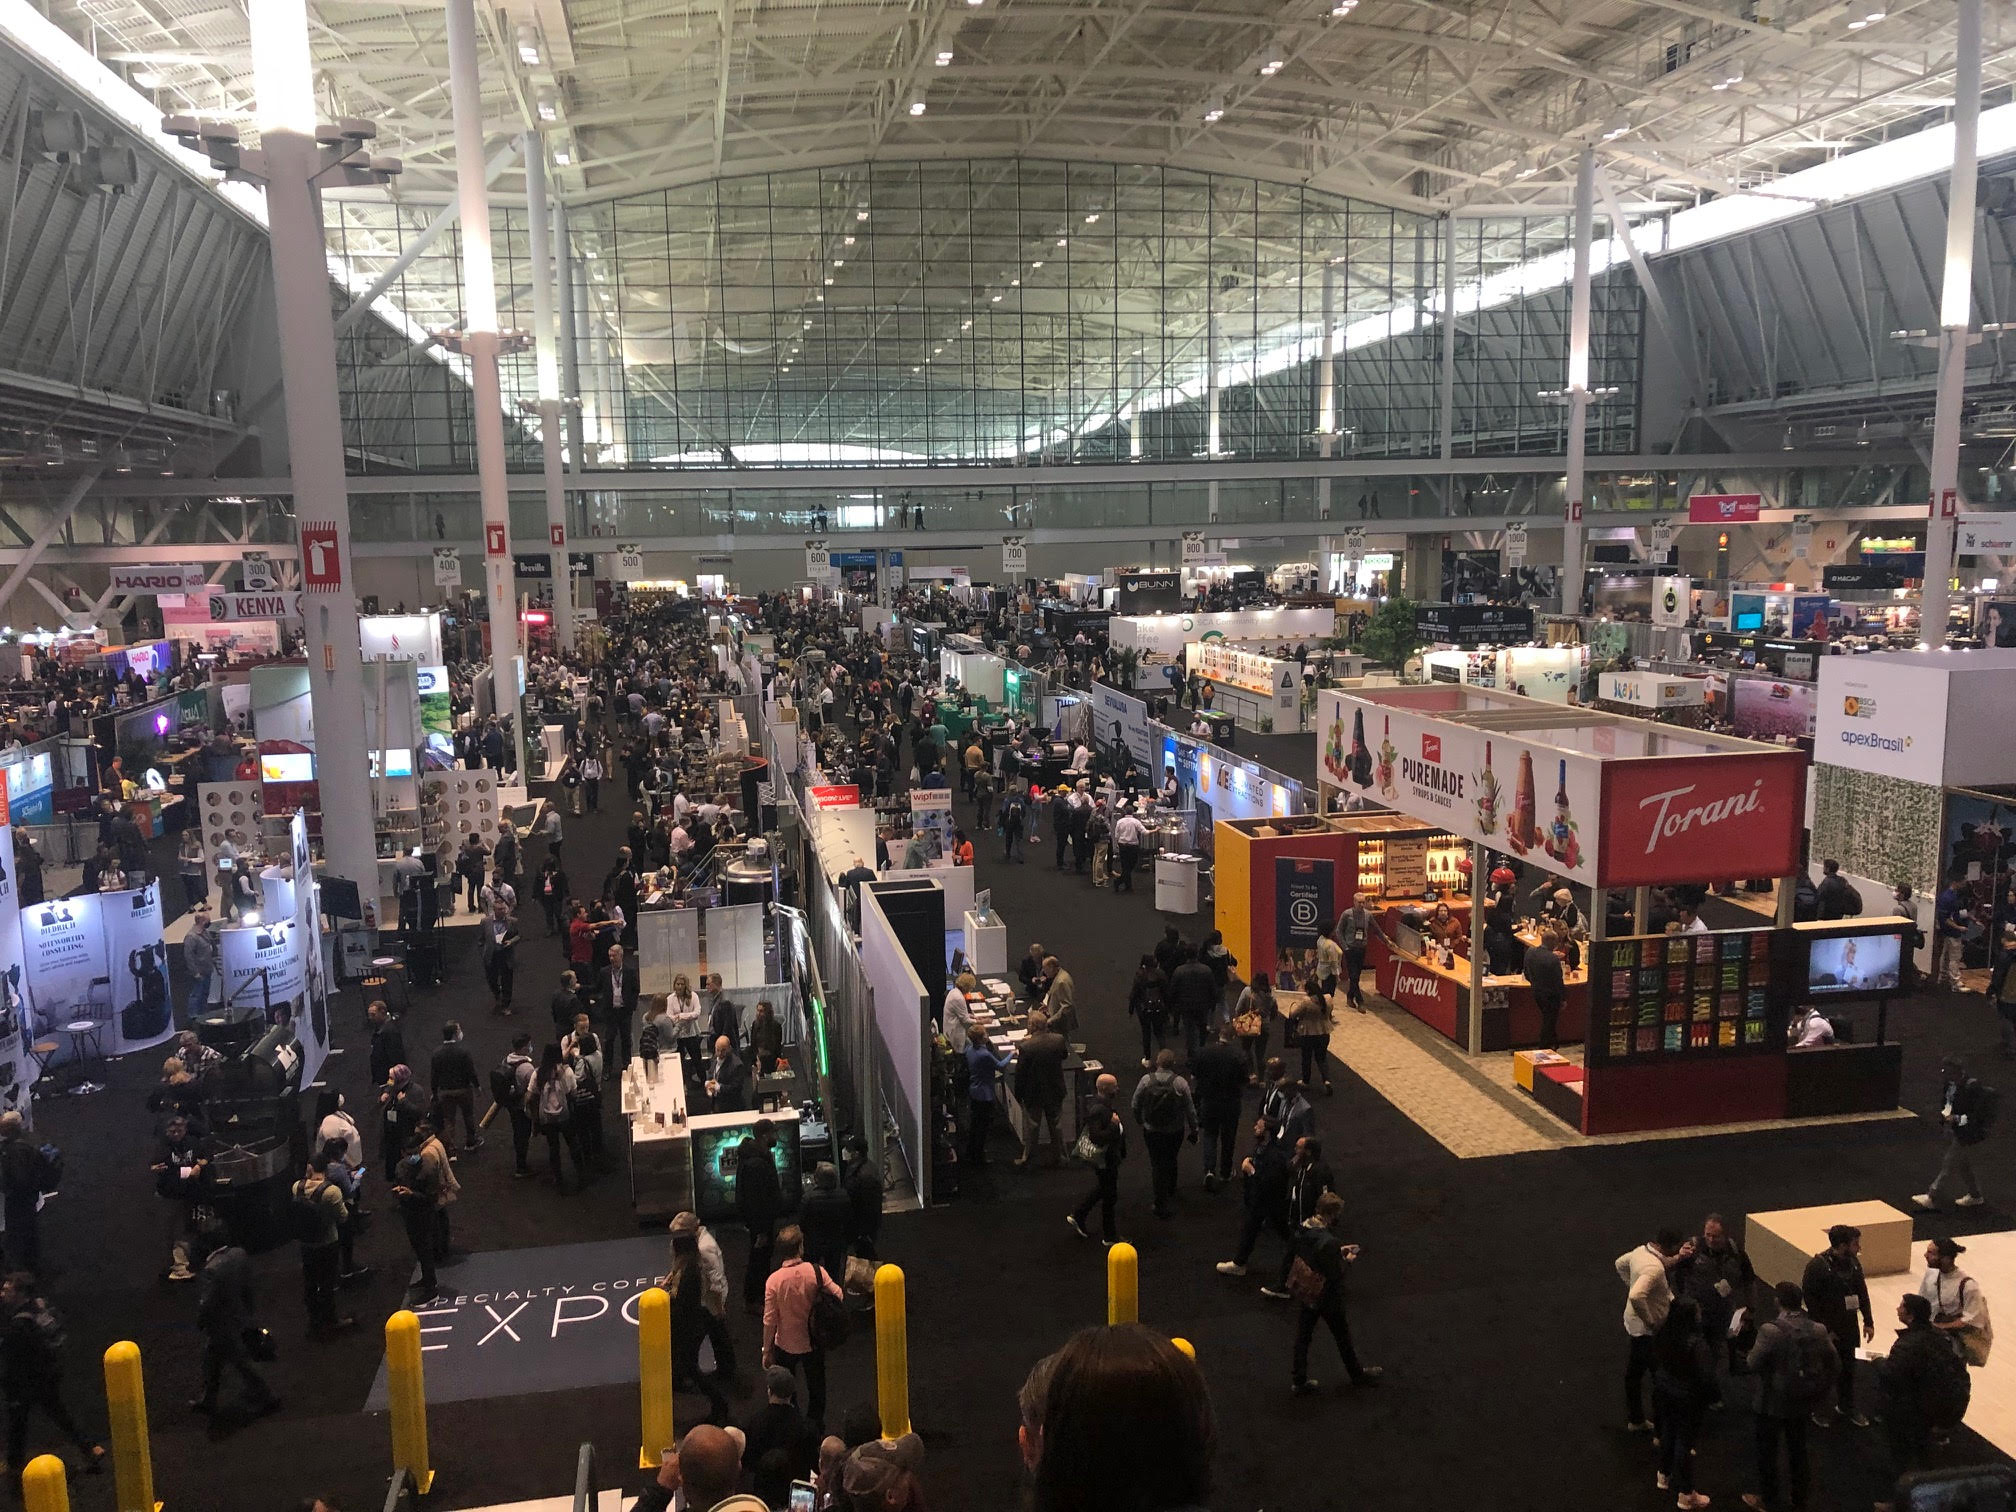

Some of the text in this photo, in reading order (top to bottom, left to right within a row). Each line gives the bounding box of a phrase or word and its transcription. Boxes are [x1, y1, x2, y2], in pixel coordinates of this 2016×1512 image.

[1509, 533, 1525, 543] 1000
[1655, 530, 1669, 539] 1100
[1186, 543, 1201, 553] 800
[1348, 538, 1361, 548] 900
[810, 552, 826, 563] 600
[1006, 549, 1022, 558] 700
[439, 560, 456, 571] 400
[622, 556, 639, 567] 500
[248, 564, 265, 575] 300
[115, 575, 182, 589] HARIO
[1139, 580, 1174, 589] BUNN
[235, 597, 286, 616] KENYA
[1137, 623, 1154, 632] ake
[1196, 618, 1214, 626] SCA
[1137, 634, 1160, 643] ffee
[132, 651, 149, 664] HARIO
[368, 652, 425, 661] LRING
[1841, 730, 1904, 753] apexBrasil
[1402, 757, 1464, 799] PUREMADE
[913, 793, 933, 803] wipf
[1412, 786, 1430, 800] SYRUPS
[1434, 793, 1452, 809] SAUCES
[1638, 779, 1767, 856] Torani
[1290, 890, 1318, 899] Certified
[1297, 904, 1311, 920] B
[40, 921, 76, 936] DIEDRICH
[41, 943, 84, 957] CONSULTING
[269, 970, 287, 981] PPORT
[1388, 952, 1443, 1004] Torani
[592, 1275, 667, 1293] COFF
